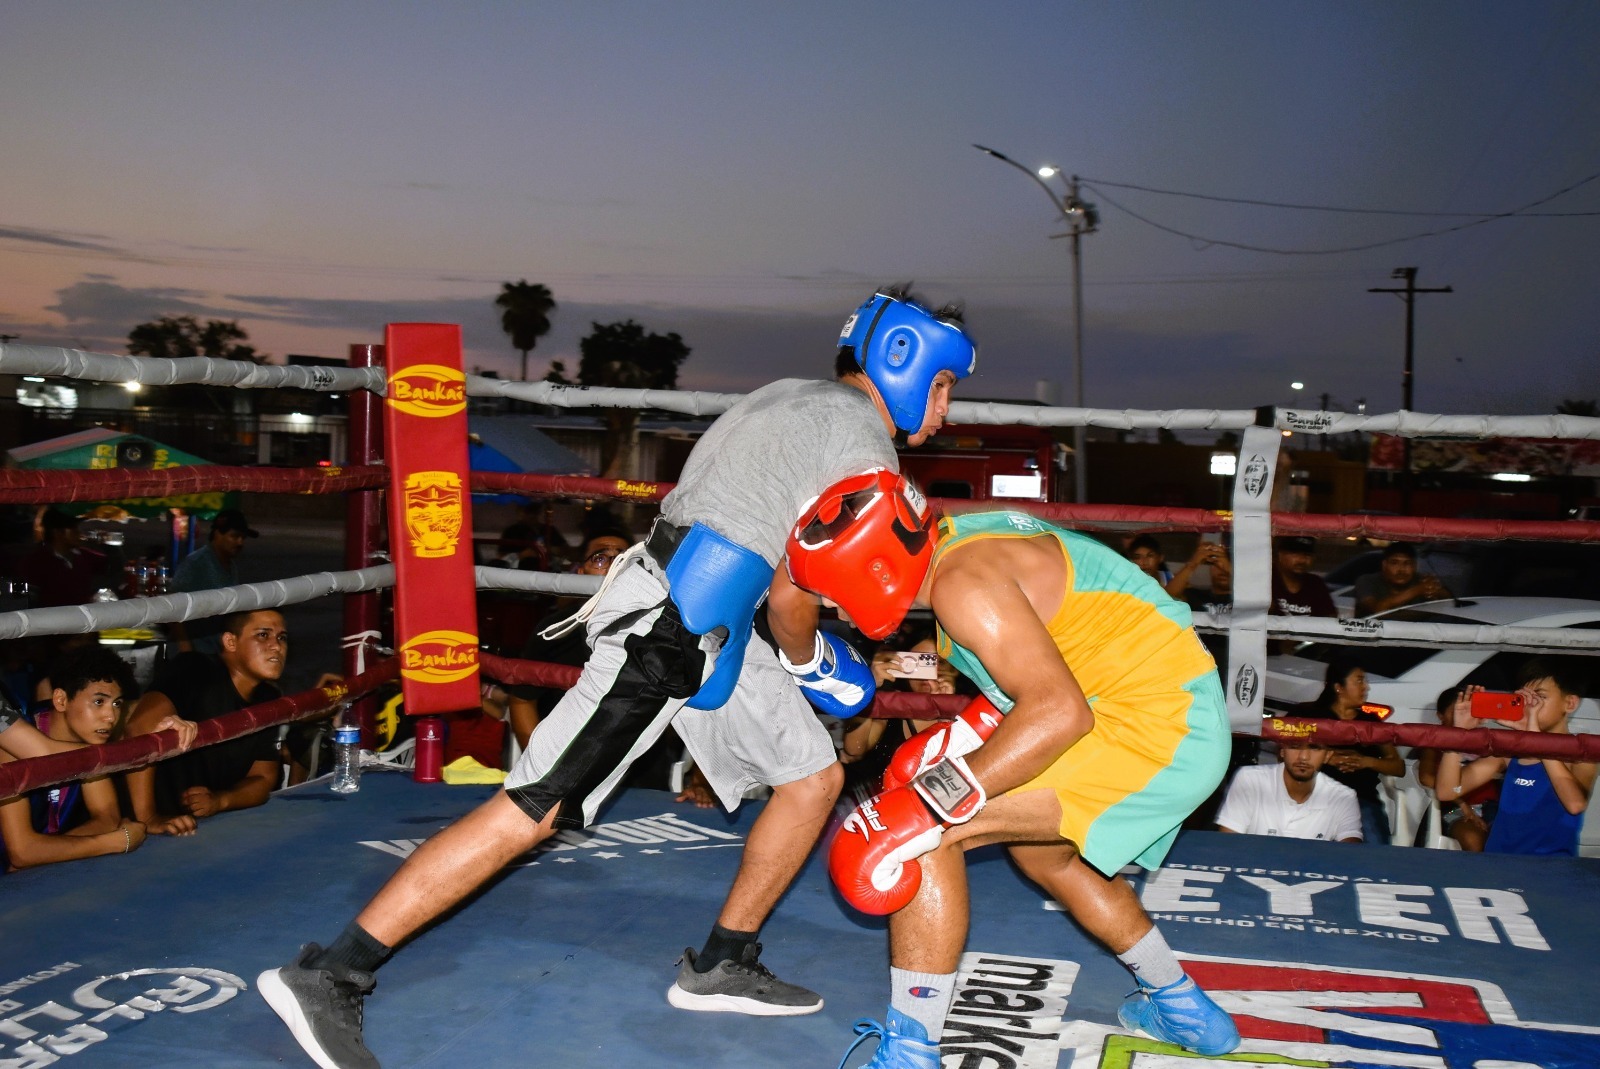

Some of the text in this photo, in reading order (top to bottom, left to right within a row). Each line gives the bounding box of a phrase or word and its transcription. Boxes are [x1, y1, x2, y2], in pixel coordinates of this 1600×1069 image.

[394, 380, 464, 401] Bankai
[1286, 411, 1332, 426] Bankai
[616, 480, 657, 494] Bankai
[1338, 617, 1384, 630] Bankai
[404, 647, 475, 668] Bankai
[1273, 719, 1317, 733] Bankai
[1044, 864, 1552, 951] EYER
[1151, 913, 1440, 943] HECHO EN MEXICO
